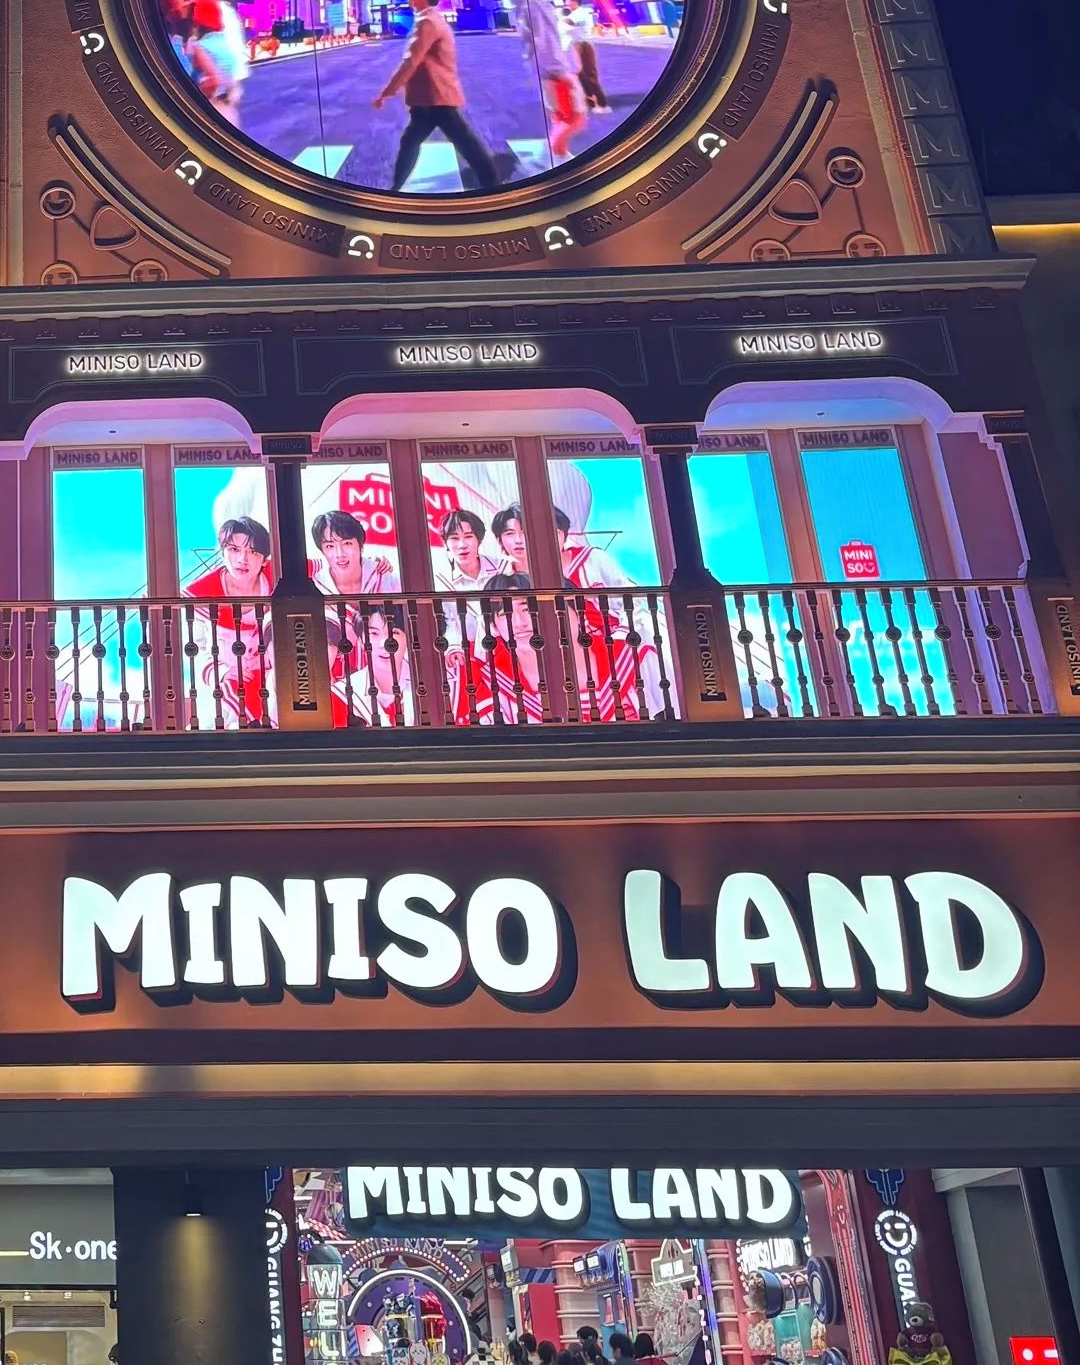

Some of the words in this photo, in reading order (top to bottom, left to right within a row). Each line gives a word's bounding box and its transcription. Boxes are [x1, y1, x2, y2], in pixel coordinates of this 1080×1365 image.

[748, 22, 781, 82] MINISO
[95, 61, 129, 105] LAND
[122, 105, 174, 159] MINISO
[723, 83, 758, 128] LAND
[635, 157, 698, 206] MINISO
[208, 182, 260, 218] LAND
[582, 199, 636, 232] LAND
[389, 243, 446, 261] LAND
[454, 237, 531, 260] MINISO
[399, 345, 471, 363] MINISO
[481, 343, 537, 360] LAND
[740, 333, 816, 353] MINISO
[824, 331, 882, 349] LAND
[69, 354, 140, 372] MINISO
[147, 352, 202, 369] LAND
[348, 446, 383, 458] LAND
[423, 445, 469, 457] MINISO
[473, 443, 509, 456] LAND
[549, 440, 596, 453] MINISO
[725, 435, 761, 449] LAND
[854, 430, 890, 444] LAND
[56, 452, 100, 464] MINISO
[105, 451, 139, 463] LAND
[844, 550, 873, 562] MINI
[295, 621, 307, 659] LAND
[696, 611, 712, 645] LAND
[1056, 605, 1076, 642] LAND
[296, 660, 310, 705] MINISO
[701, 645, 719, 698] MINISO
[62, 871, 560, 998] MINISO
[623, 868, 1028, 1000] LAND
[347, 1166, 584, 1221] MINISO
[610, 1167, 793, 1224] LAND
[313, 1269, 340, 1365] WEL
